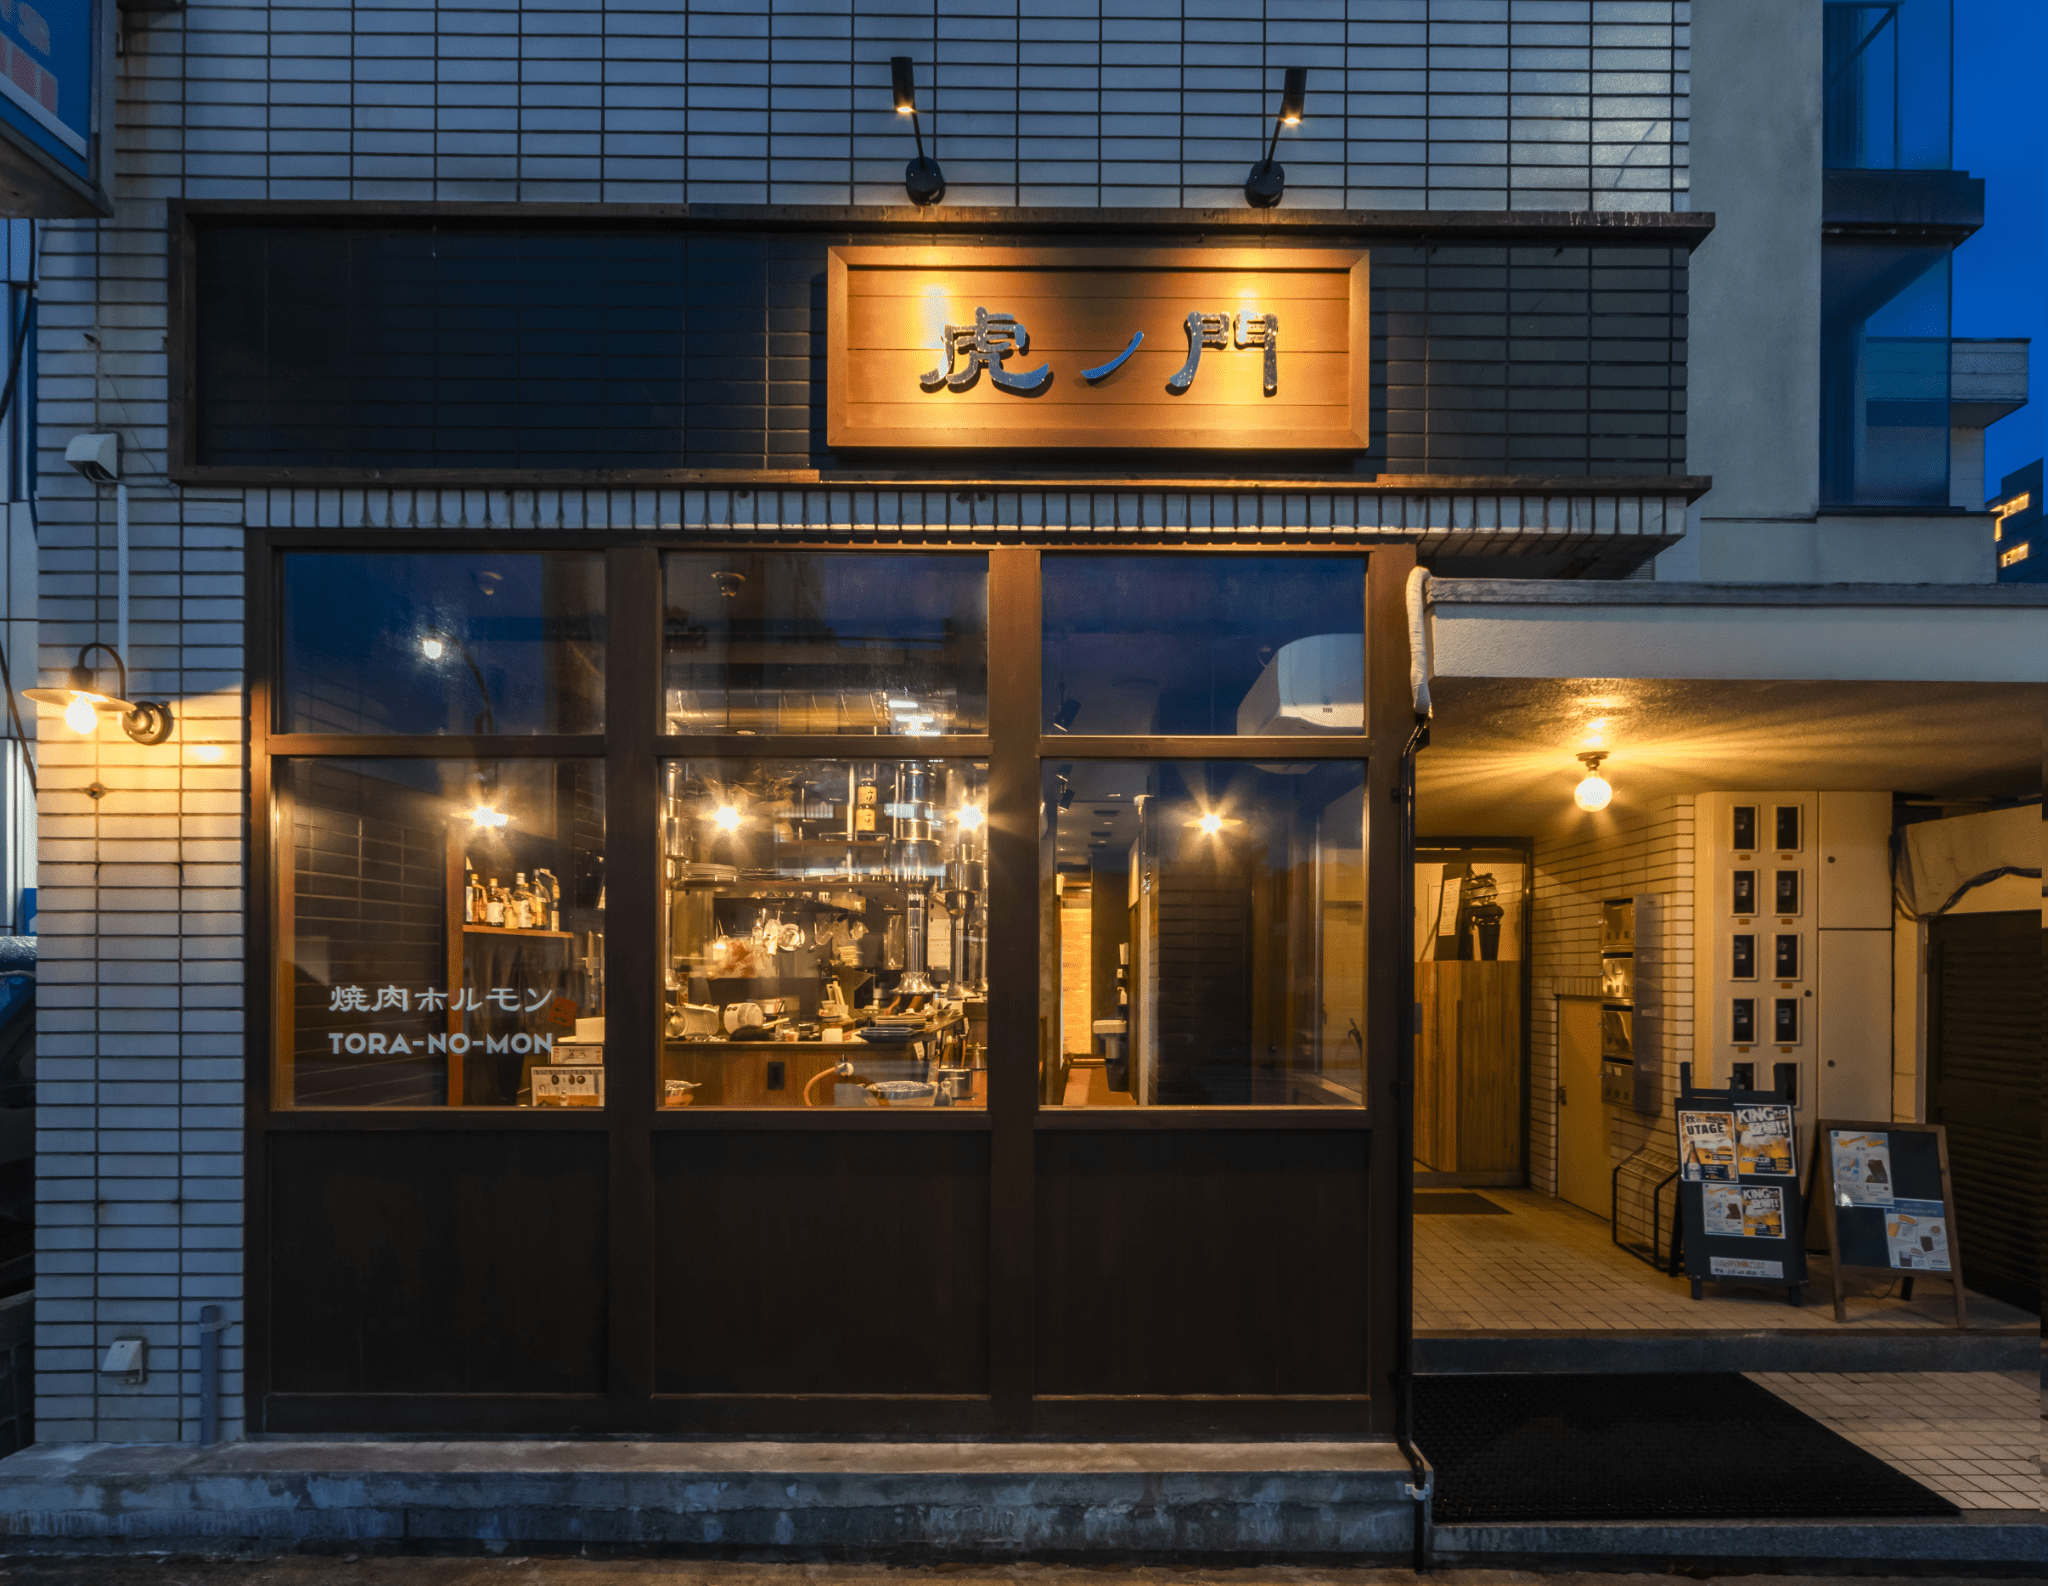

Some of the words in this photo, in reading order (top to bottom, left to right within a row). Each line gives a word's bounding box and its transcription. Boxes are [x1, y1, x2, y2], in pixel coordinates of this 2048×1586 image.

[918, 305, 1279, 390] 虎ノ門
[328, 984, 553, 1013] 焼肉ホルモン
[327, 1032, 553, 1055] TORA-NO-MON
[1736, 1107, 1776, 1124] KING
[1686, 1122, 1725, 1136] UTAGE
[1742, 1188, 1770, 1200] KING
